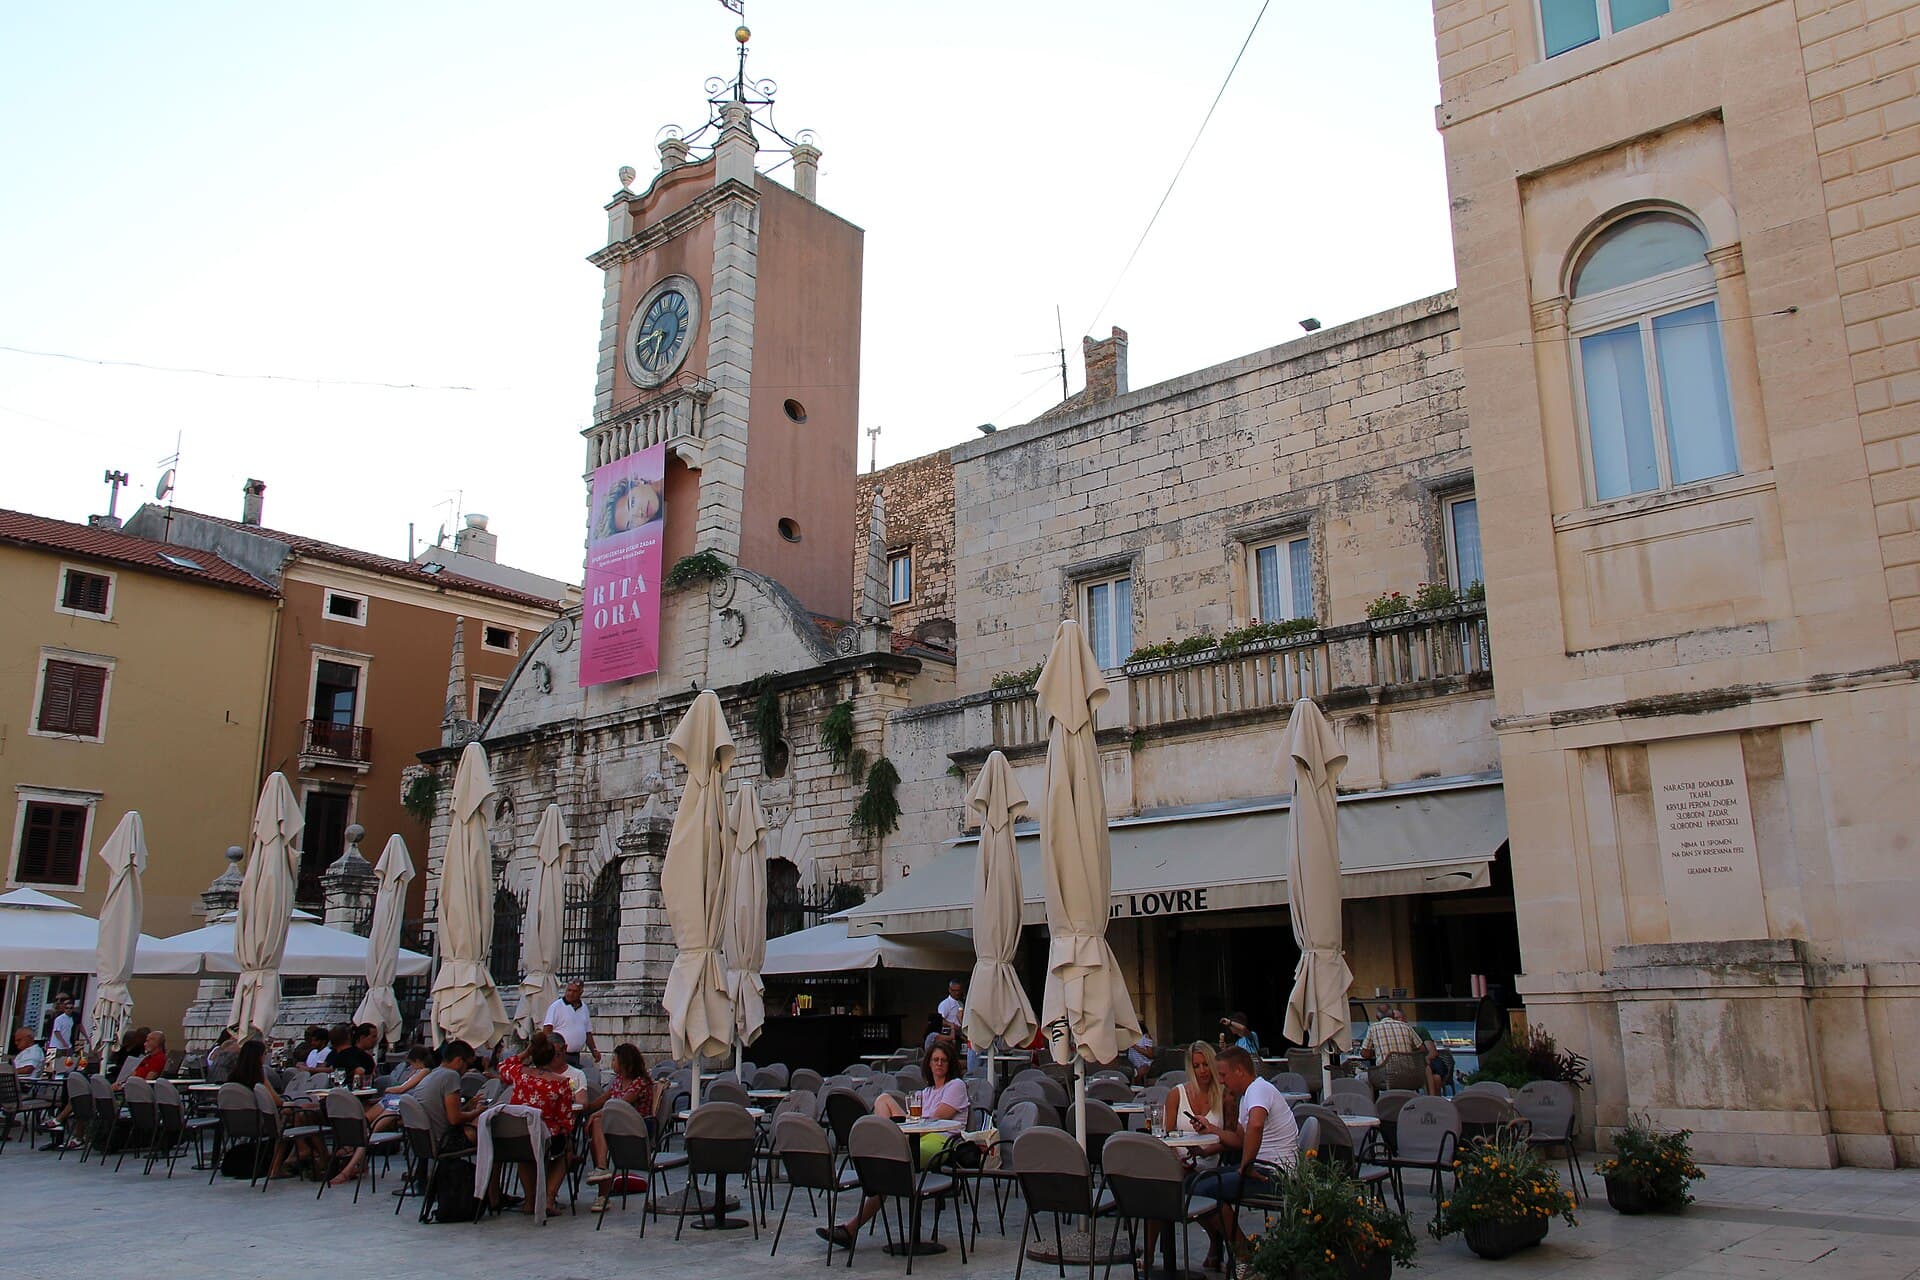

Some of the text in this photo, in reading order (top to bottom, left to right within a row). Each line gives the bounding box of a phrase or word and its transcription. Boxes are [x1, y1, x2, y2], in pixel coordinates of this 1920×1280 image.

[592, 573, 647, 607] RITA
[594, 599, 641, 629] ORA
[1708, 809, 1728, 817] ZADAR
[1130, 888, 1208, 916] LOVRE
